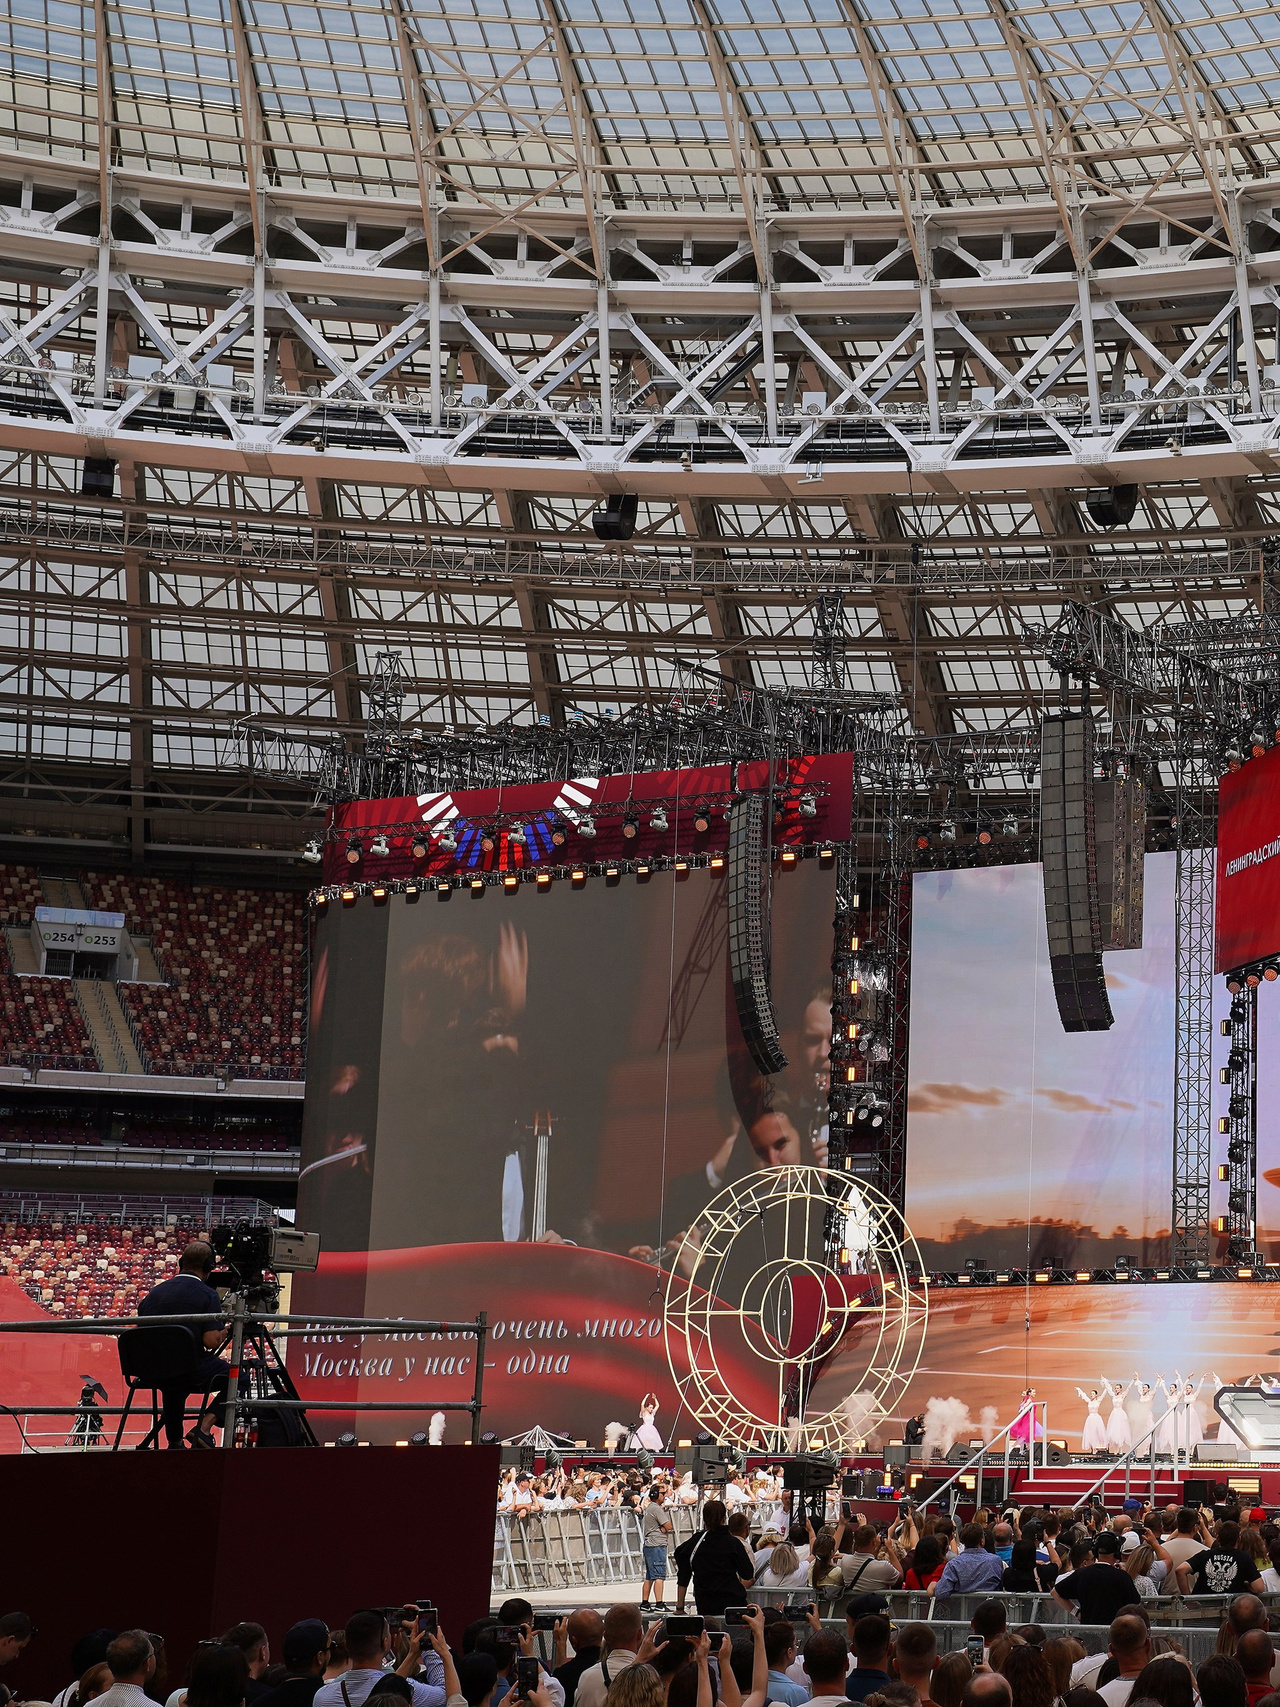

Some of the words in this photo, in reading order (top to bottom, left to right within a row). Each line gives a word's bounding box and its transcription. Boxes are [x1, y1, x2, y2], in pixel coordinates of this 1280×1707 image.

[51, 932, 75, 943] 254
[93, 935, 117, 946] 253
[491, 1318, 569, 1341] очень
[576, 1316, 662, 1339] много
[299, 1352, 395, 1378] Москва
[398, 1356, 417, 1382] у
[423, 1356, 471, 1376] нас
[507, 1348, 571, 1376] одна
[1213, 1554, 1234, 1563] RUSSIA
